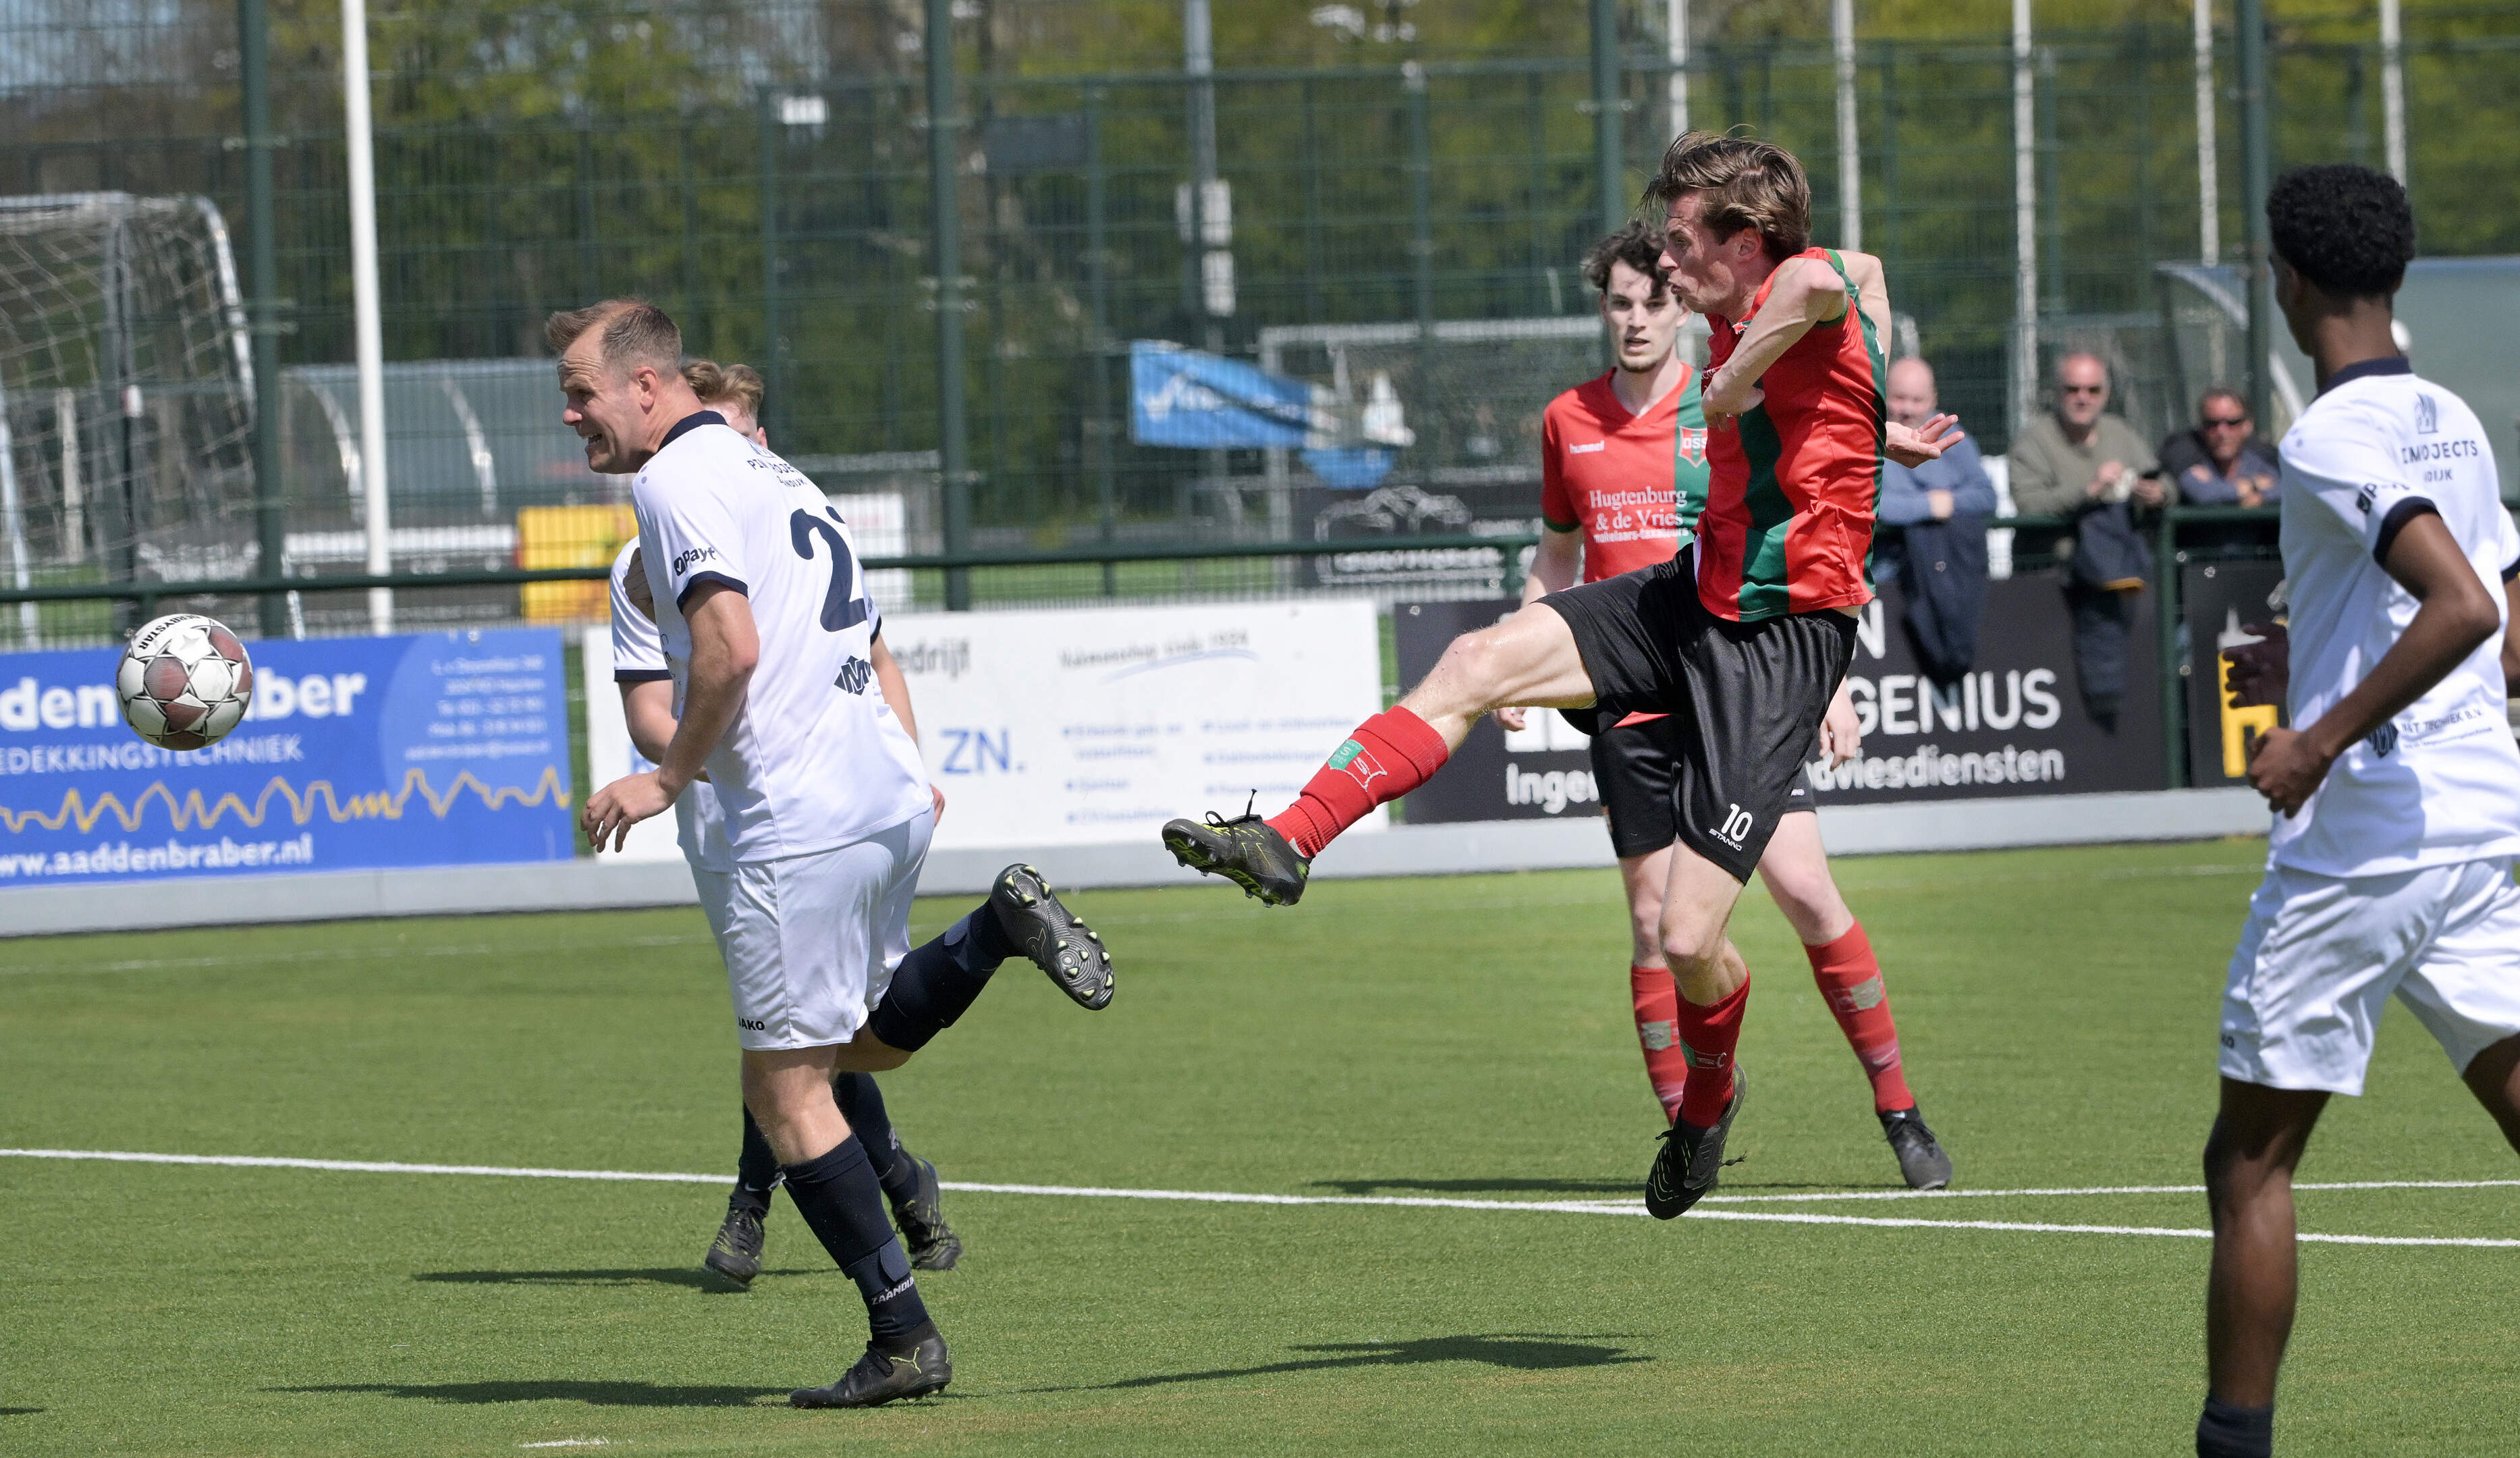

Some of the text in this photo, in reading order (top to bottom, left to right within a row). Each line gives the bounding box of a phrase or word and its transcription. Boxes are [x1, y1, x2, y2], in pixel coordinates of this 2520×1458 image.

[1589, 486, 1688, 510] Hugtenburg
[1596, 508, 1684, 531] & de Vries
[682, 547, 717, 568] Payt
[790, 505, 869, 632] 2
[244, 666, 368, 721] ber
[940, 727, 1026, 775] ZN.
[1721, 803, 1753, 842] 10
[1708, 828, 1743, 852] STANNO
